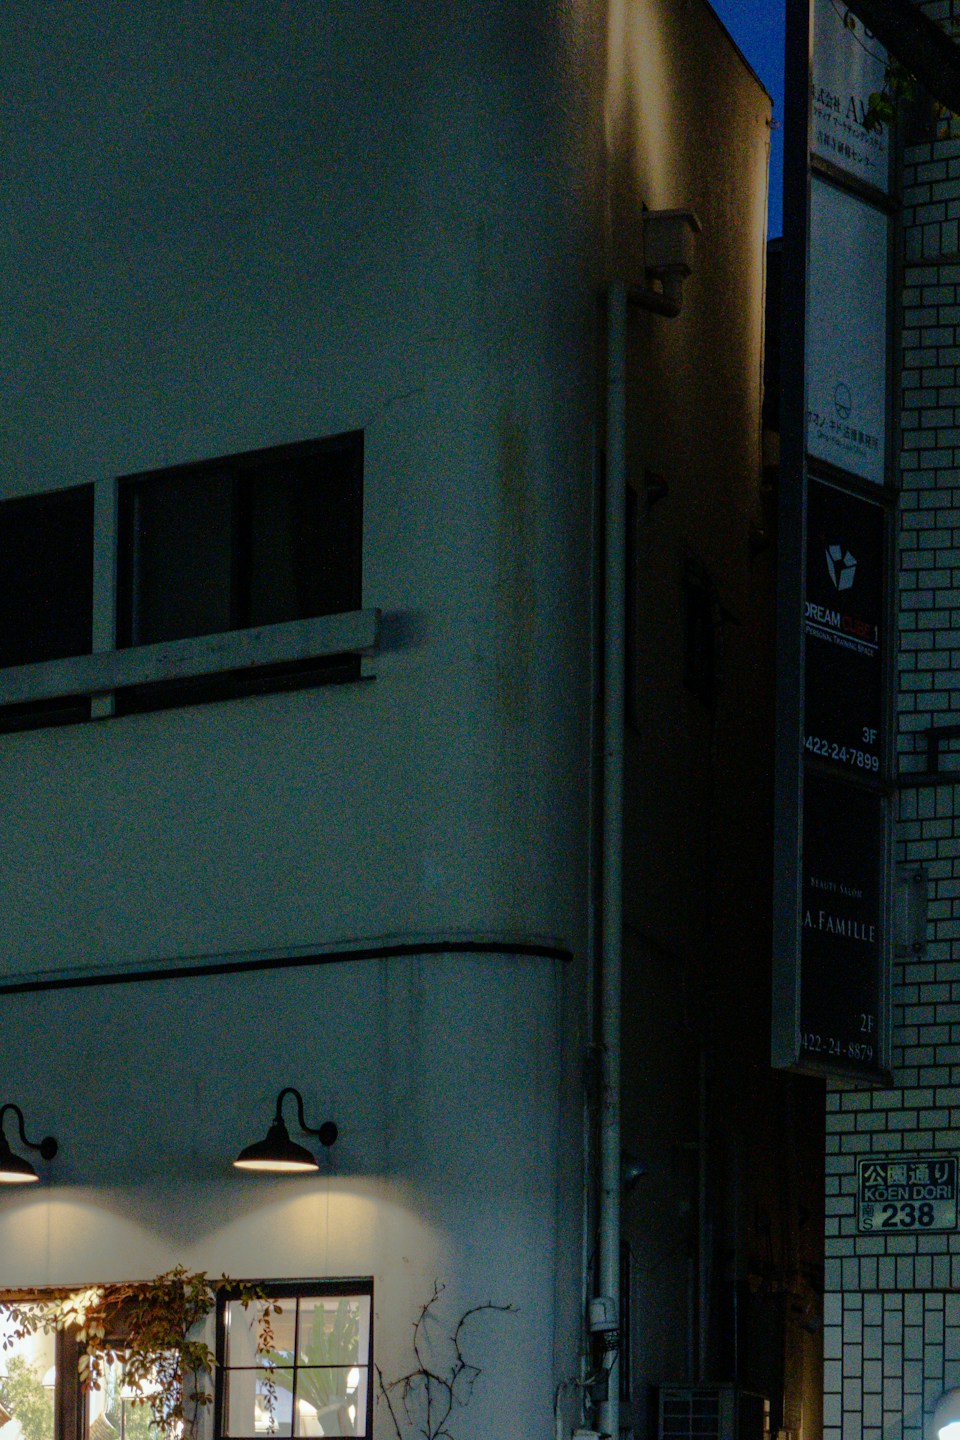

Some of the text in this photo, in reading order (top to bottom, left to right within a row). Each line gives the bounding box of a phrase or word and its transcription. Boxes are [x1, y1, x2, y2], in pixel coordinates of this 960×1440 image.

[862, 726, 878, 744] 3F
[801, 909, 876, 943] A.FAMILLE
[800, 1032, 874, 1062] 422-24-8879
[864, 1163, 949, 1186] 公園通り
[912, 1185, 952, 1199] DORI
[882, 1203, 934, 1228] 238
